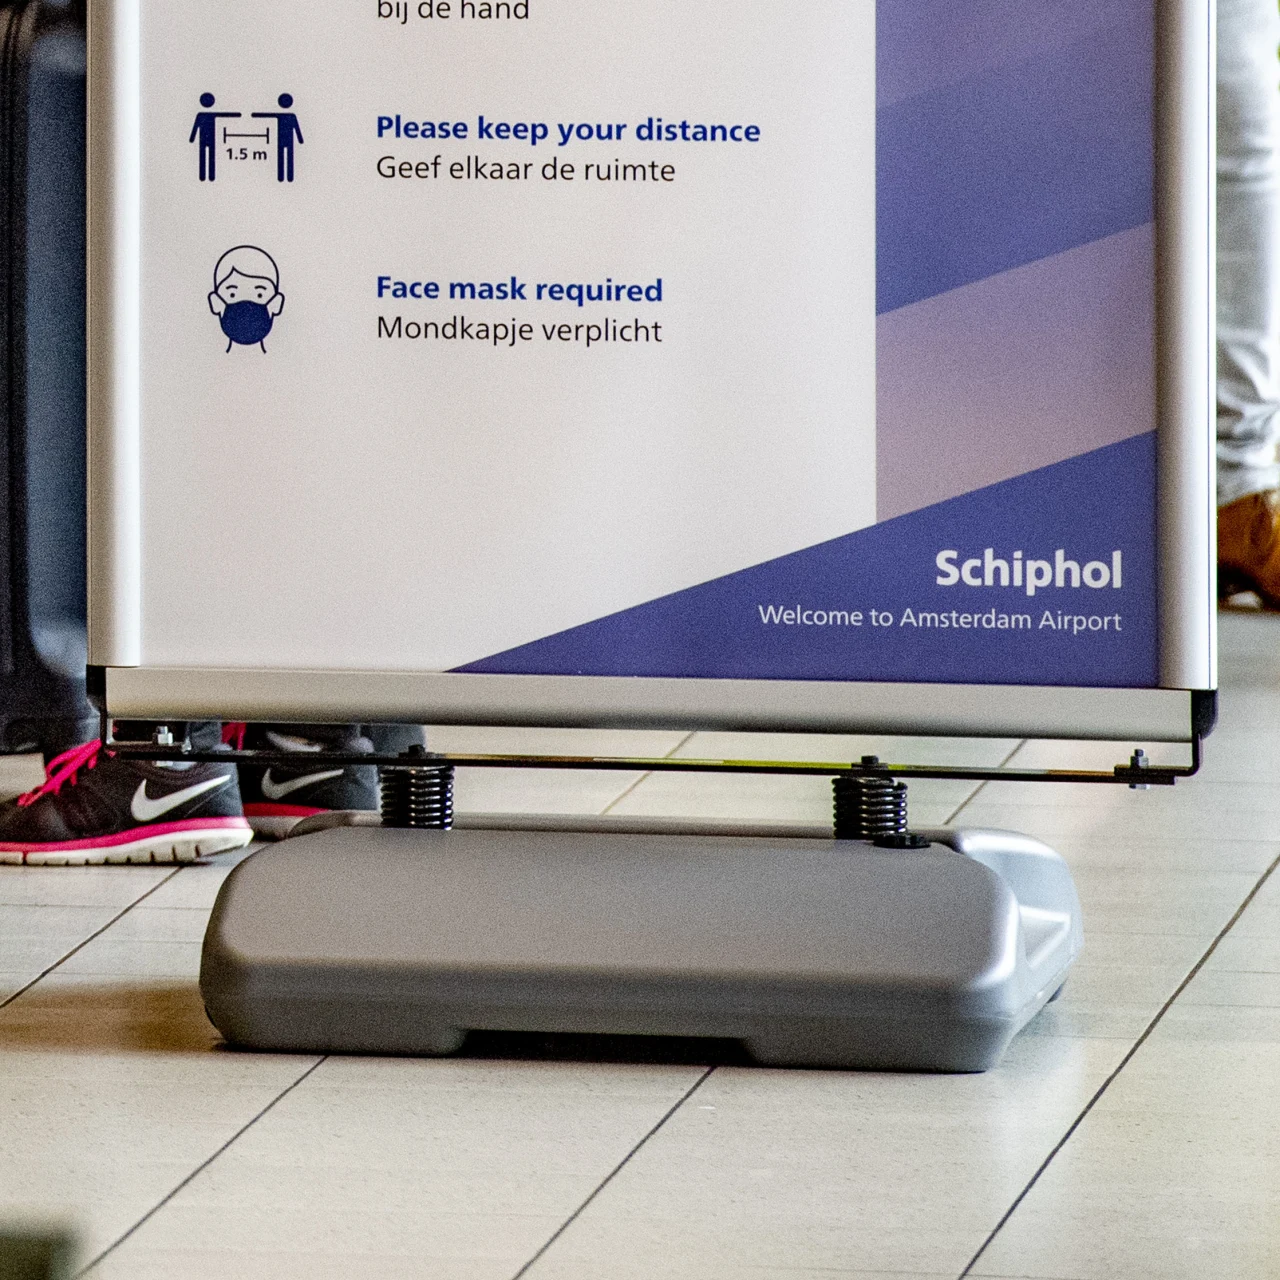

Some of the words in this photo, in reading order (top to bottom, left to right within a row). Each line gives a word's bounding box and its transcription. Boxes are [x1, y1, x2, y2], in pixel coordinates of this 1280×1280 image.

[377, 114, 469, 140] Please
[477, 115, 549, 146] keep
[557, 123, 628, 147] your
[635, 116, 761, 143] distance
[226, 148, 248, 160] 1.5
[252, 150, 268, 161] m
[376, 154, 442, 180] Geef
[449, 154, 534, 181] elkaar
[541, 156, 576, 181] de
[584, 158, 676, 182] ruimte
[377, 275, 440, 300] Face
[449, 276, 527, 301] mask
[536, 277, 663, 308] required
[377, 315, 534, 347] Mondkapje
[541, 317, 662, 347] verplicht
[935, 547, 1122, 597] Schiphol
[758, 604, 864, 627] Welcome
[869, 608, 894, 627] to
[899, 607, 1032, 629] Amsterdam
[1038, 610, 1122, 635] Airport
